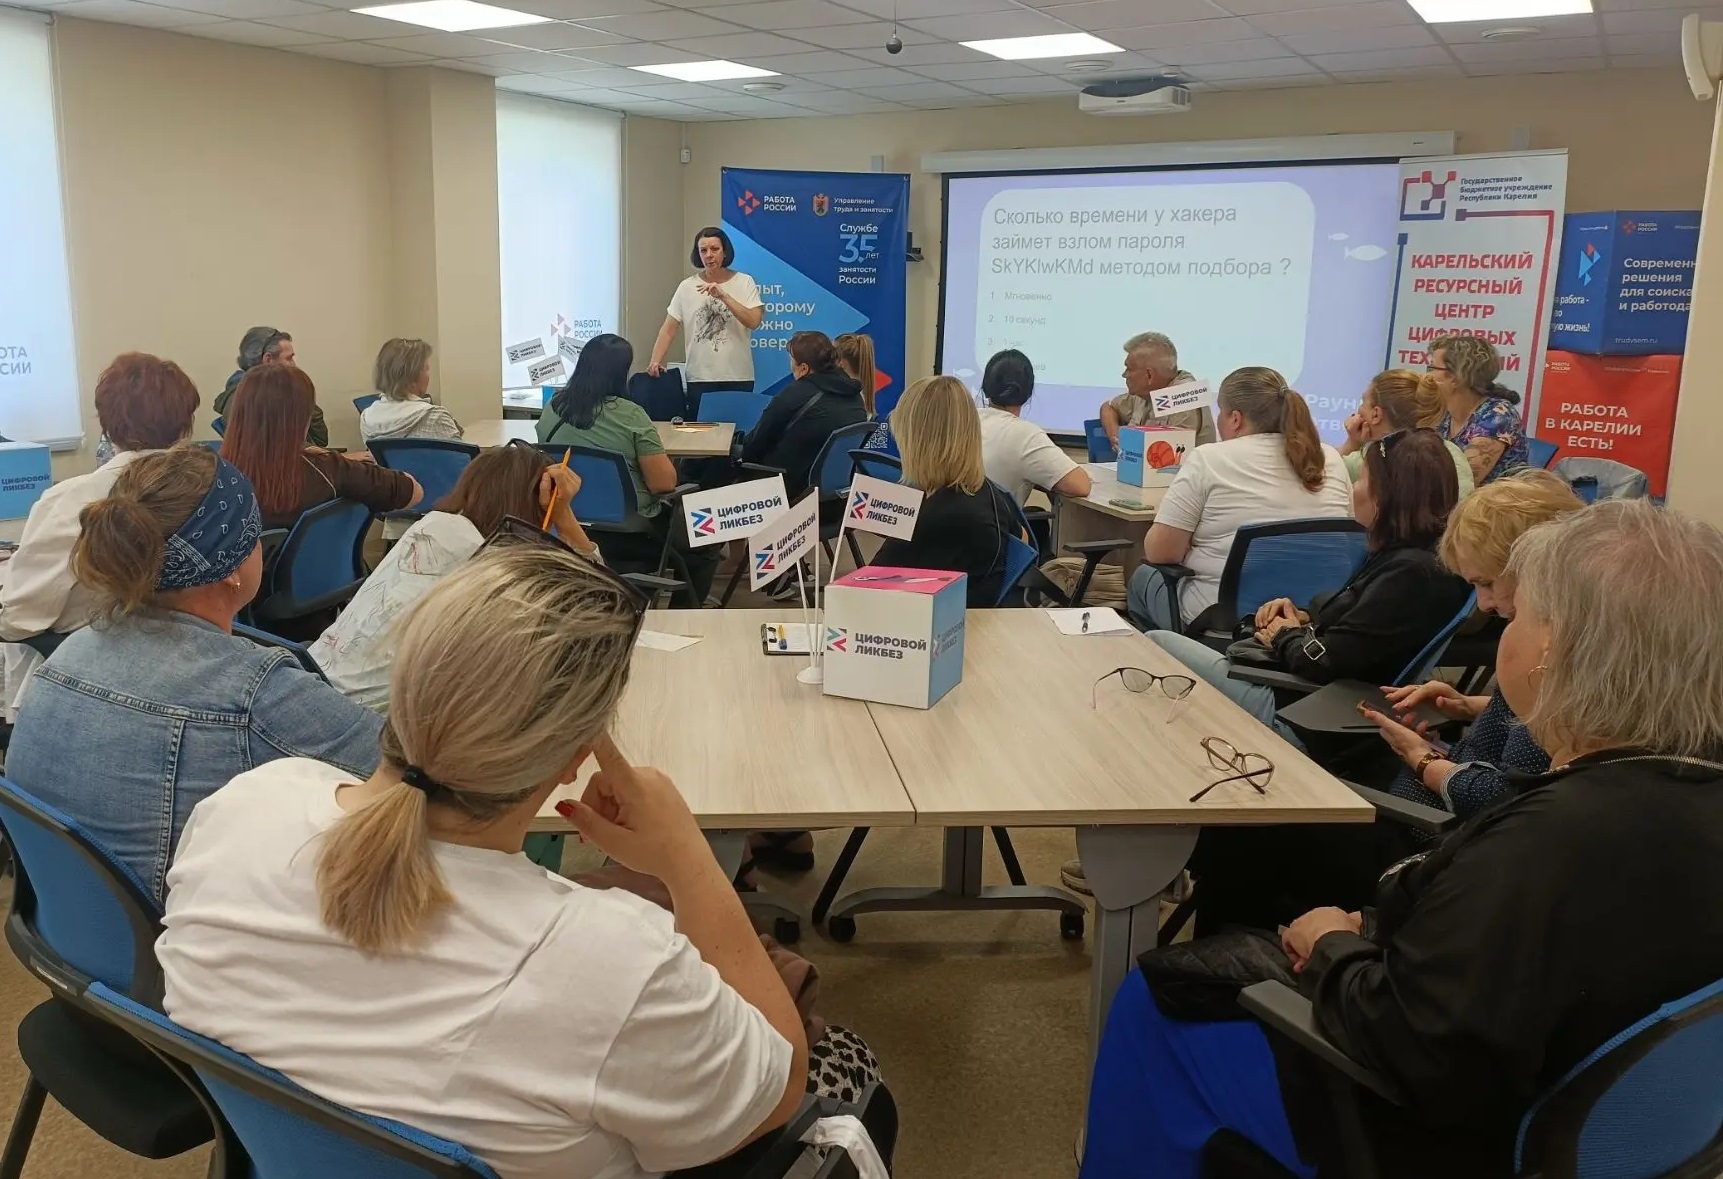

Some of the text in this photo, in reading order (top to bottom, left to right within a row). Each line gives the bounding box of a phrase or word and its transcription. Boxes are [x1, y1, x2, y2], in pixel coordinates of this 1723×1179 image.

[1460, 176, 1522, 186] Государственное
[1460, 183, 1553, 195] бюджетное учреждение
[763, 195, 795, 204] РАБОТА
[833, 197, 875, 206] Управление
[1460, 193, 1501, 202] Республики
[763, 204, 797, 212] РОССИИ
[833, 206, 853, 214] труда
[994, 206, 1237, 227] Сколько времени у хакера
[839, 223, 878, 235] Службе
[993, 232, 1185, 252] займет взлом пароля
[864, 252, 880, 260] лет
[1411, 251, 1533, 269] КАРЕЛЬСКИЙ
[1100, 261, 1180, 278] методом
[1188, 257, 1272, 279] подбора
[1280, 258, 1291, 275] ?
[1624, 257, 1698, 272] Современн
[838, 275, 876, 285] России
[1622, 274, 1682, 284] решения
[754, 284, 785, 298] пыт,
[1413, 277, 1523, 295] РЕСУРСНЫЙ
[1619, 287, 1692, 298] для соиска
[1004, 291, 1052, 301] Мгновенно
[1559, 294, 1585, 305] работа
[764, 302, 815, 316] орому
[1434, 303, 1495, 320] ЦЕНТР
[1619, 300, 1692, 312] и работода
[574, 320, 602, 328] РАБОТА
[758, 320, 793, 331] жно
[1564, 322, 1590, 332] жизнь!
[750, 338, 788, 351] овер
[0, 346, 27, 359] ОТА
[0, 361, 31, 375] СИИ
[1171, 387, 1207, 400] ЦИФРОВОЙ
[1173, 397, 1198, 406] ЛИКБЕЗ
[1305, 393, 1356, 412] Раун
[1560, 403, 1629, 418] РАБОТА
[1545, 418, 1642, 436] В КАРЕЛИИ
[1567, 436, 1614, 450] ЕСТЬ!
[1, 473, 50, 485] ЦИФРОВОЙ
[717, 496, 782, 518] ЦИФРОВОЙ
[869, 498, 916, 518] ЦИФРОВОЙ
[719, 514, 763, 530] ЛИКБЕЗ
[866, 511, 898, 526] ЛИКБЕЗ
[777, 512, 816, 551] ЦИФРОВОЙ
[778, 535, 806, 564] ЛИКБЕЗ
[855, 632, 927, 651] ЦИФРОВОЙ
[855, 645, 903, 660] ЛИКБЕЗ
